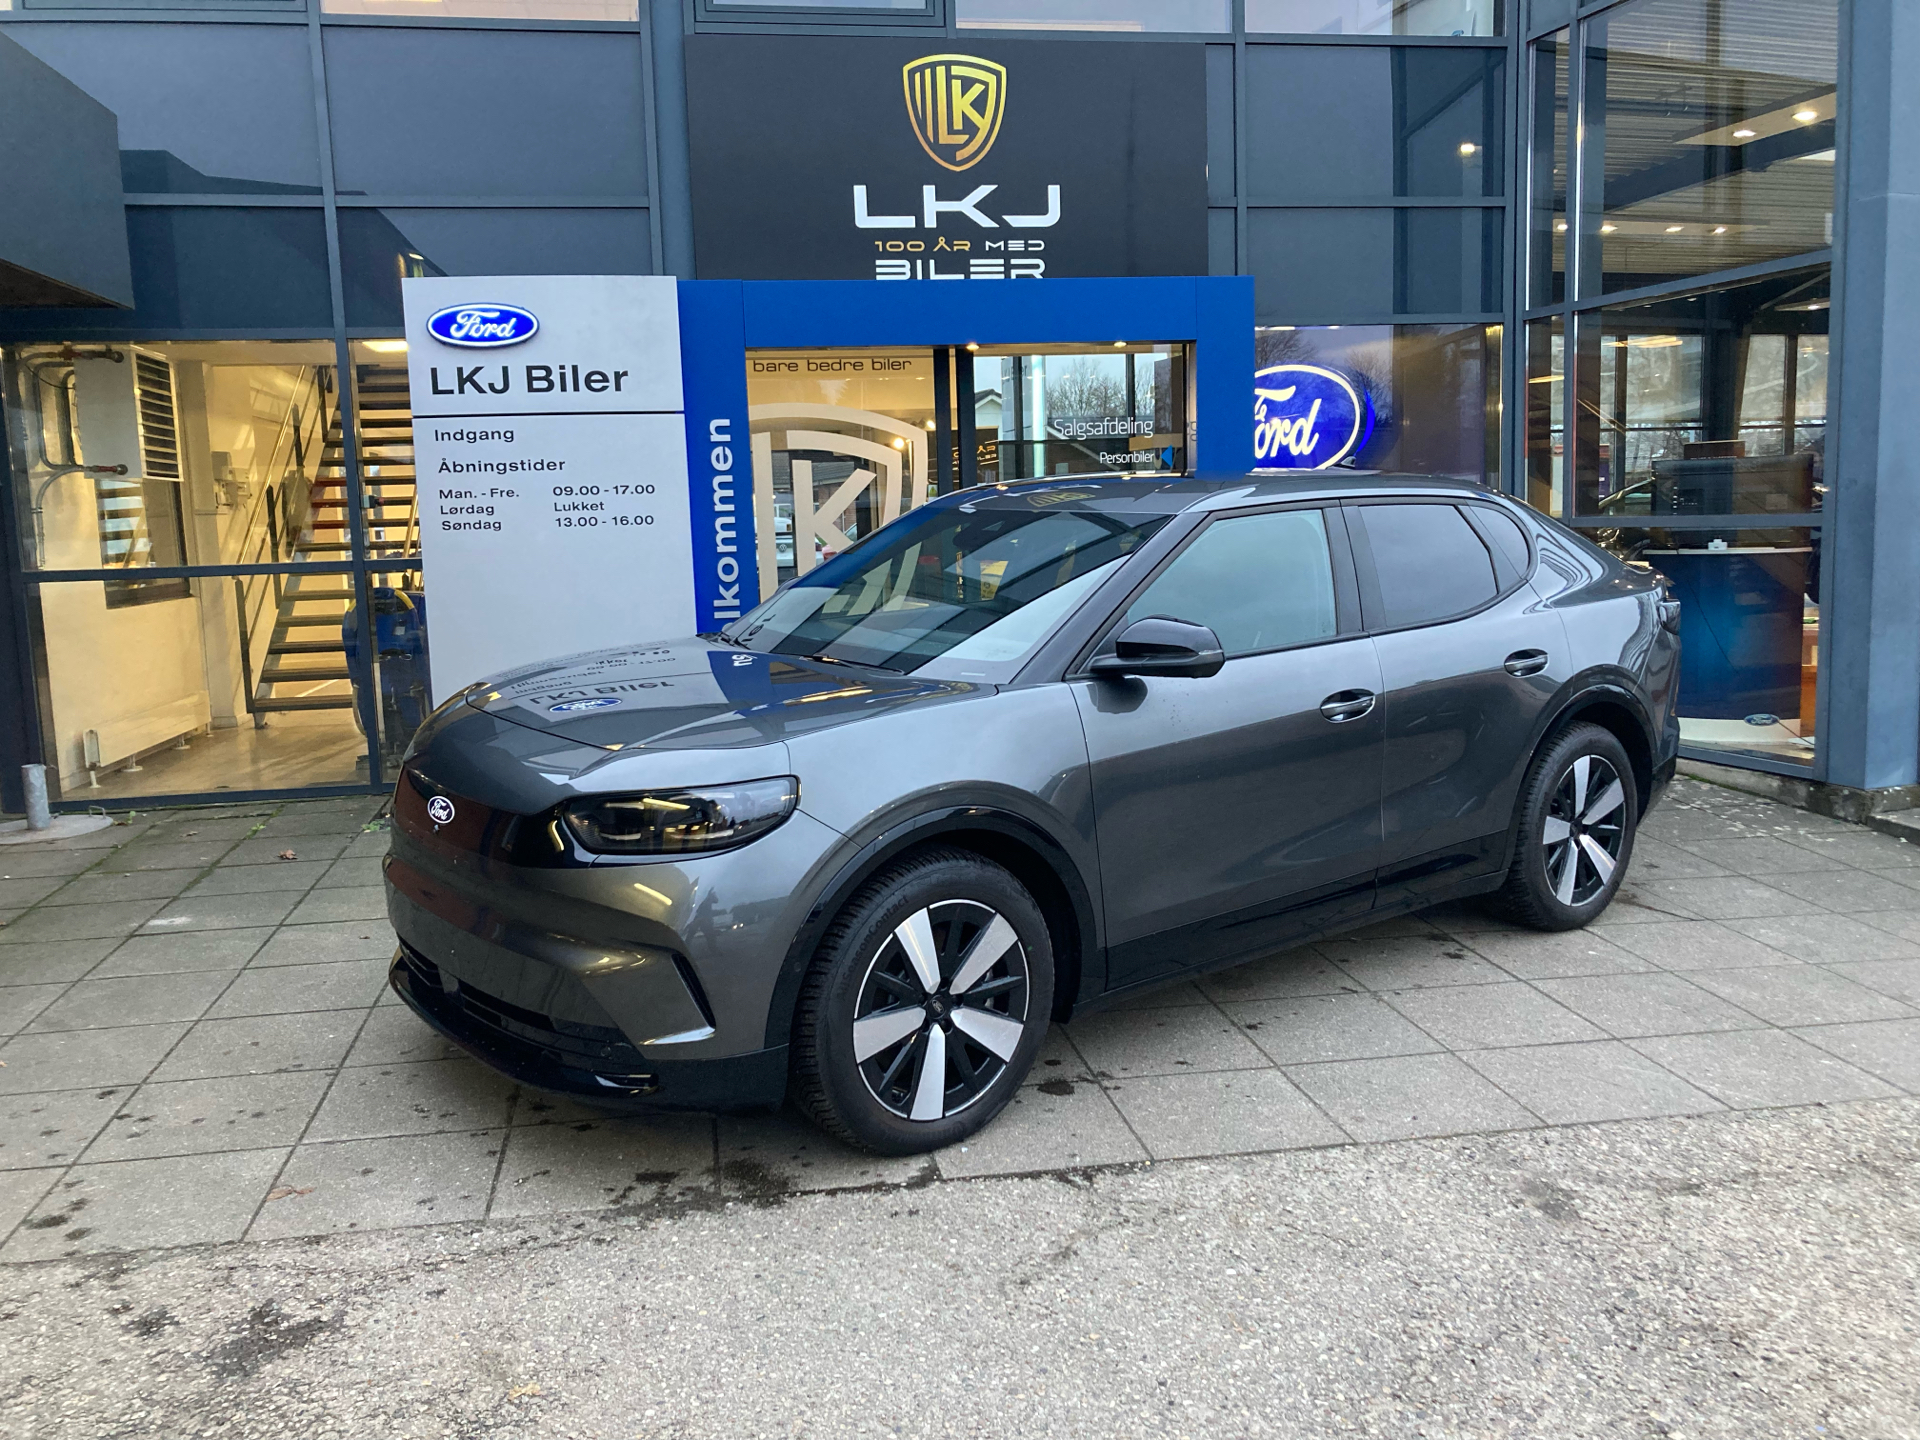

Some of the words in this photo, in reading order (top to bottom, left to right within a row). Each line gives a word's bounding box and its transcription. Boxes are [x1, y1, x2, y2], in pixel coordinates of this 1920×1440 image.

[853, 184, 1061, 228] LKJ
[874, 240, 925, 252] 100
[933, 236, 971, 252] ÅR
[985, 239, 1045, 252] MED
[875, 258, 1045, 281] BILER
[450, 309, 517, 338] Ford
[752, 359, 799, 373] bare
[806, 358, 864, 372] bedre
[871, 357, 912, 371] biler
[430, 365, 511, 395] LKJ
[525, 364, 629, 394] Biler
[434, 428, 515, 444] Indgang
[1053, 416, 1154, 441] Salgsafdeling
[1099, 450, 1155, 464] Personbiler
[438, 457, 566, 475] Åbningstider
[438, 489, 478, 500] Man.
[490, 487, 520, 498] Fre.
[552, 485, 600, 497] 09.00
[612, 484, 655, 495] 17.00
[440, 504, 495, 516] Lørdag
[553, 501, 605, 512] Lukket
[441, 520, 502, 532] Søndag
[555, 516, 598, 528] 13.00
[611, 515, 654, 526] 16.00
